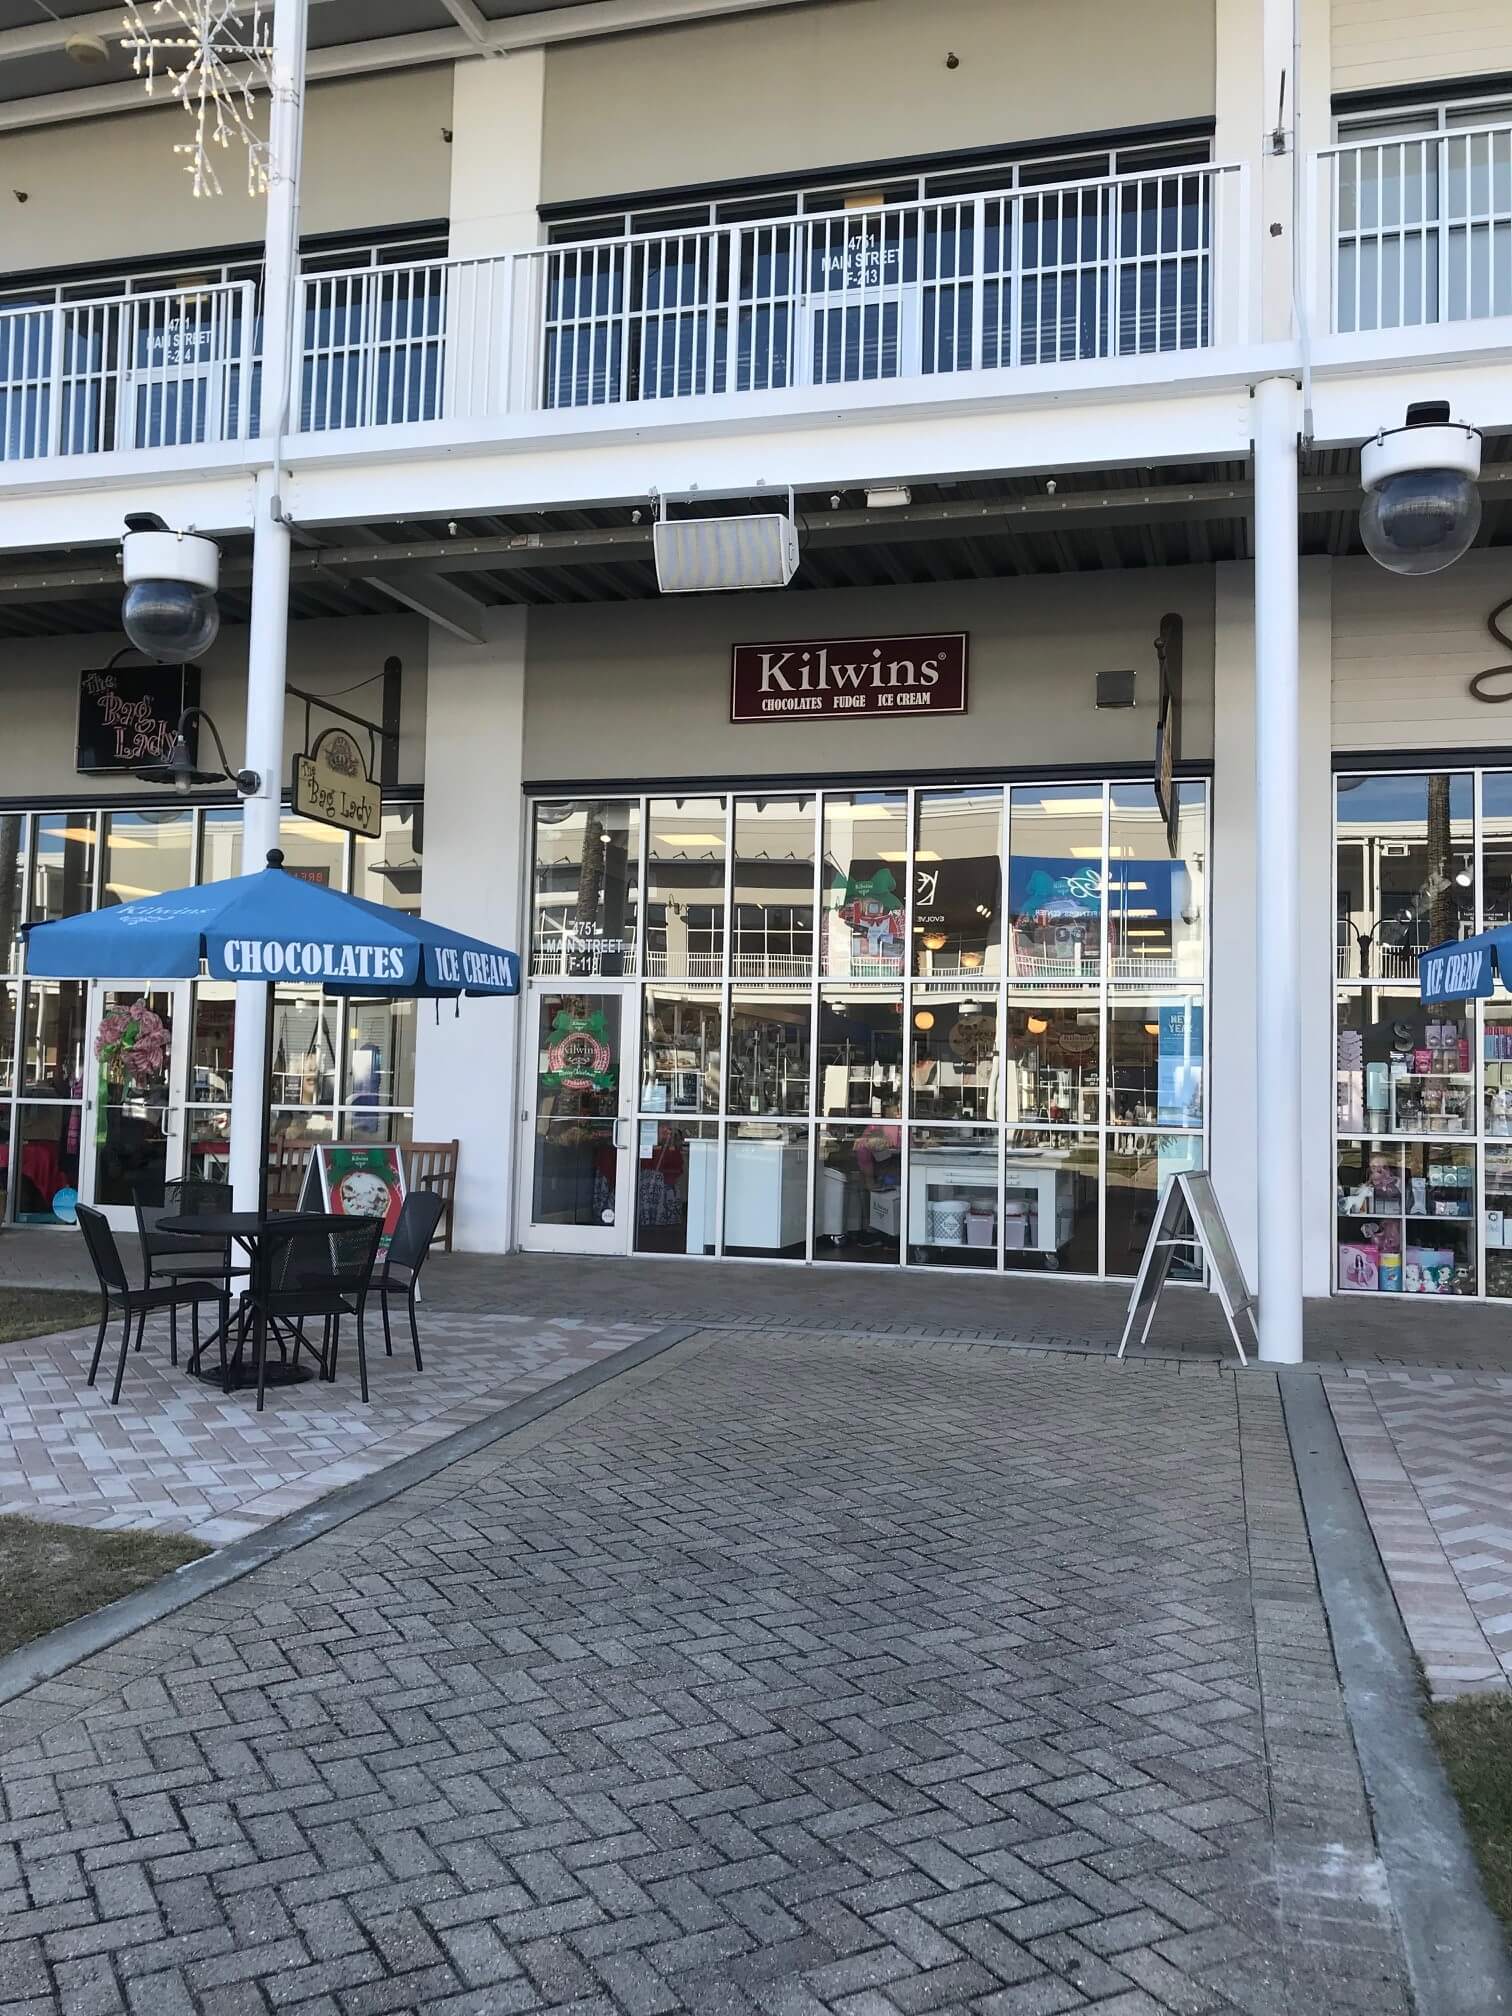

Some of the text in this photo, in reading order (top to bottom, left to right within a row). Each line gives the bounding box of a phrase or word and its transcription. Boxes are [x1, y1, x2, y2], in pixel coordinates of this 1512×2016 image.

[848, 234, 875, 251] 4751
[821, 248, 902, 272] MAIN STREET
[846, 269, 877, 286] F-213
[168, 317, 190, 331] 471
[173, 330, 213, 347] SREET
[167, 349, 191, 362] F-24
[82, 672, 115, 694] The
[762, 692, 931, 711] CHOCOLATES FUDGE ICE CREAM
[114, 720, 179, 764] Lady
[301, 761, 316, 777] The
[308, 776, 373, 829] Bag Lady
[573, 920, 597, 936] 4751
[546, 938, 622, 953] MAN STREET
[224, 939, 404, 978] CHOCOLATES
[434, 947, 513, 987] ICE CREAM
[1426, 950, 1483, 996] ICE CREAM
